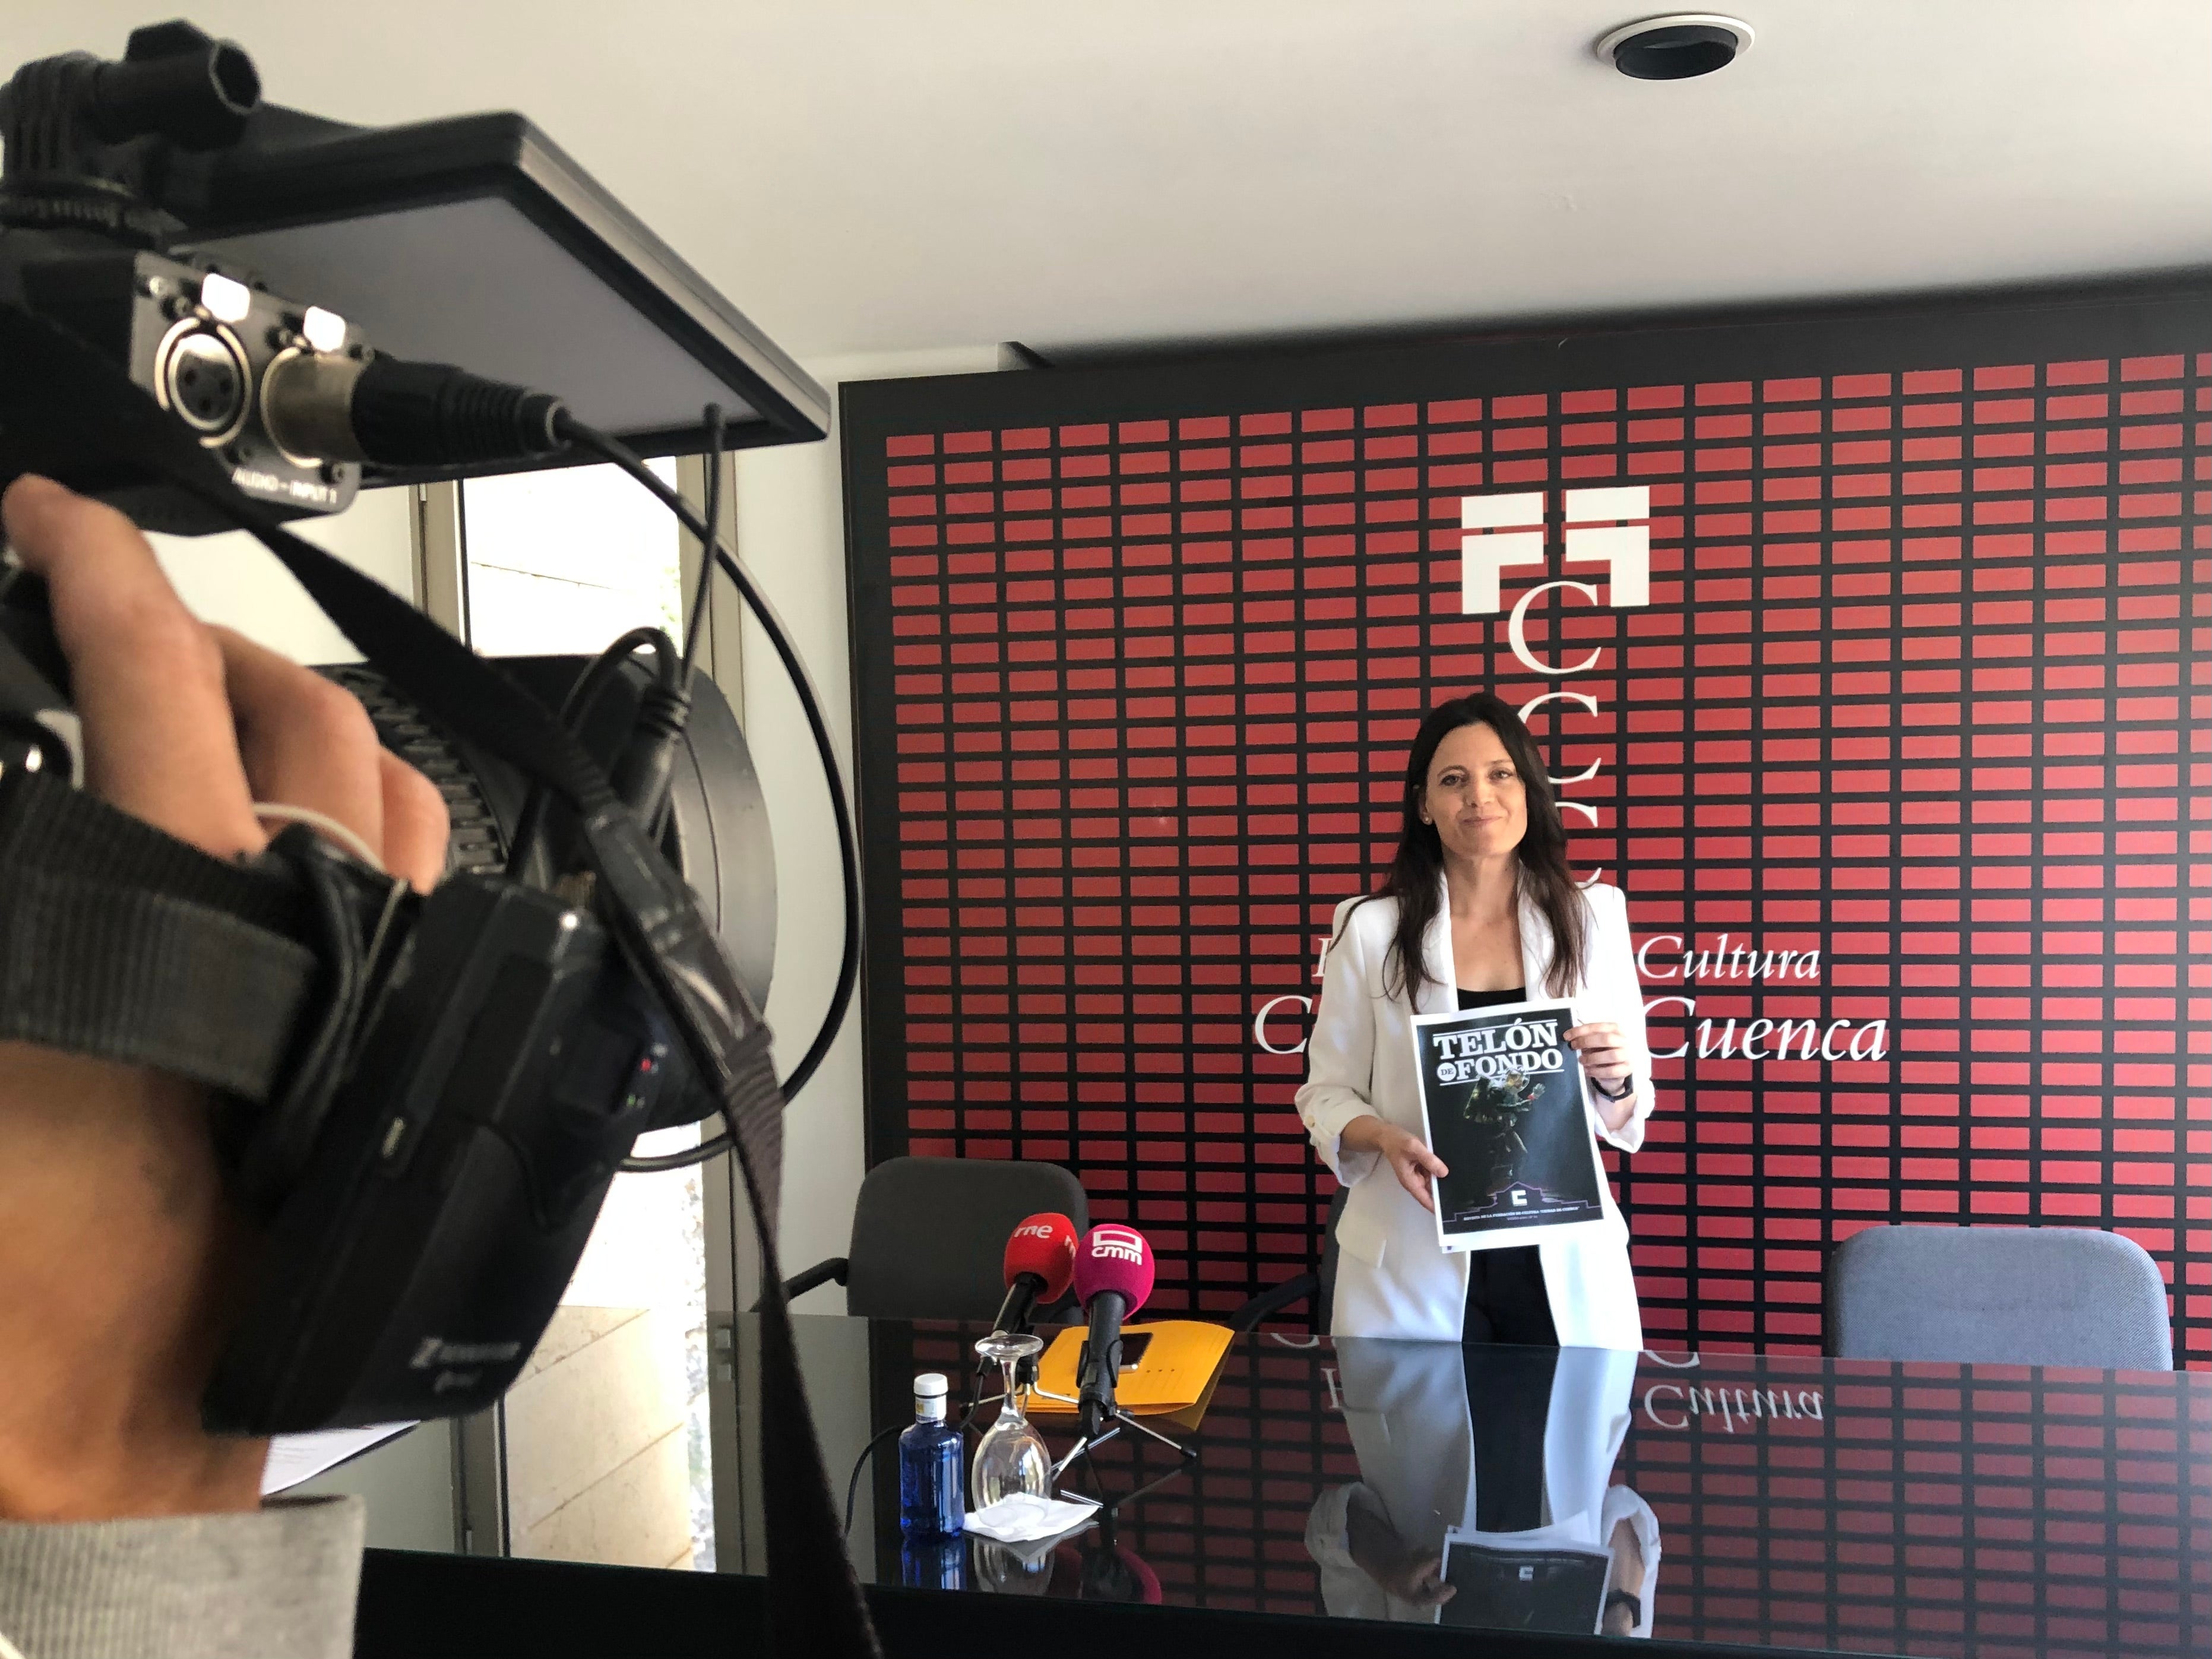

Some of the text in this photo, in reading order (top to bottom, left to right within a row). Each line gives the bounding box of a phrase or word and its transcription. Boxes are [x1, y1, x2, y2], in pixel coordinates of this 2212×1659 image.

[1637, 933, 1821, 980] Cultura
[1433, 1018, 1558, 1060] TELÓN
[1643, 996, 1888, 1062] Cuenca
[1455, 1049, 1563, 1081] FONDO
[1014, 1224, 1053, 1239] rne
[1091, 1246, 1143, 1266] cmm
